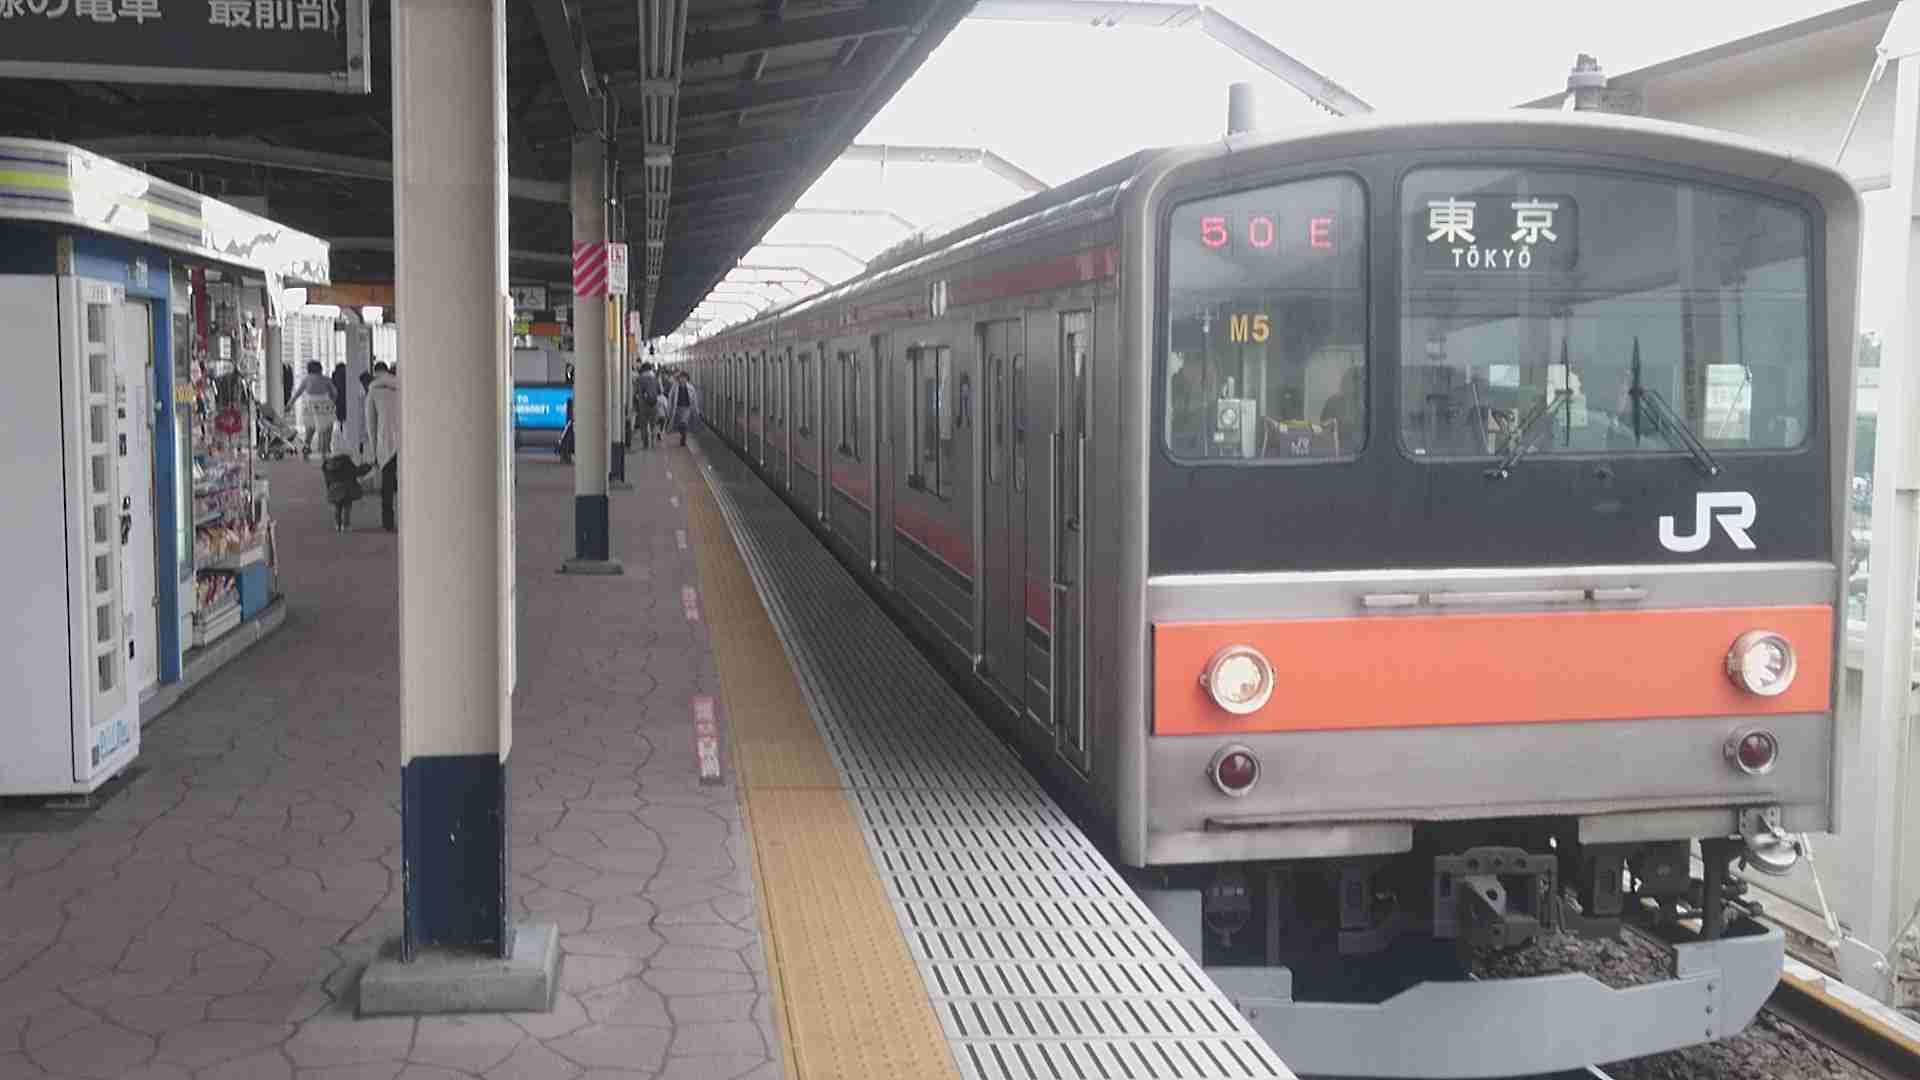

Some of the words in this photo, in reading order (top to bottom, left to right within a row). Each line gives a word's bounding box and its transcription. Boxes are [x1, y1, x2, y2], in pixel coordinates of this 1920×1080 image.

[1427, 197, 1559, 243] 東京
[1231, 313, 1270, 342] M5
[1658, 491, 1757, 552] JR
